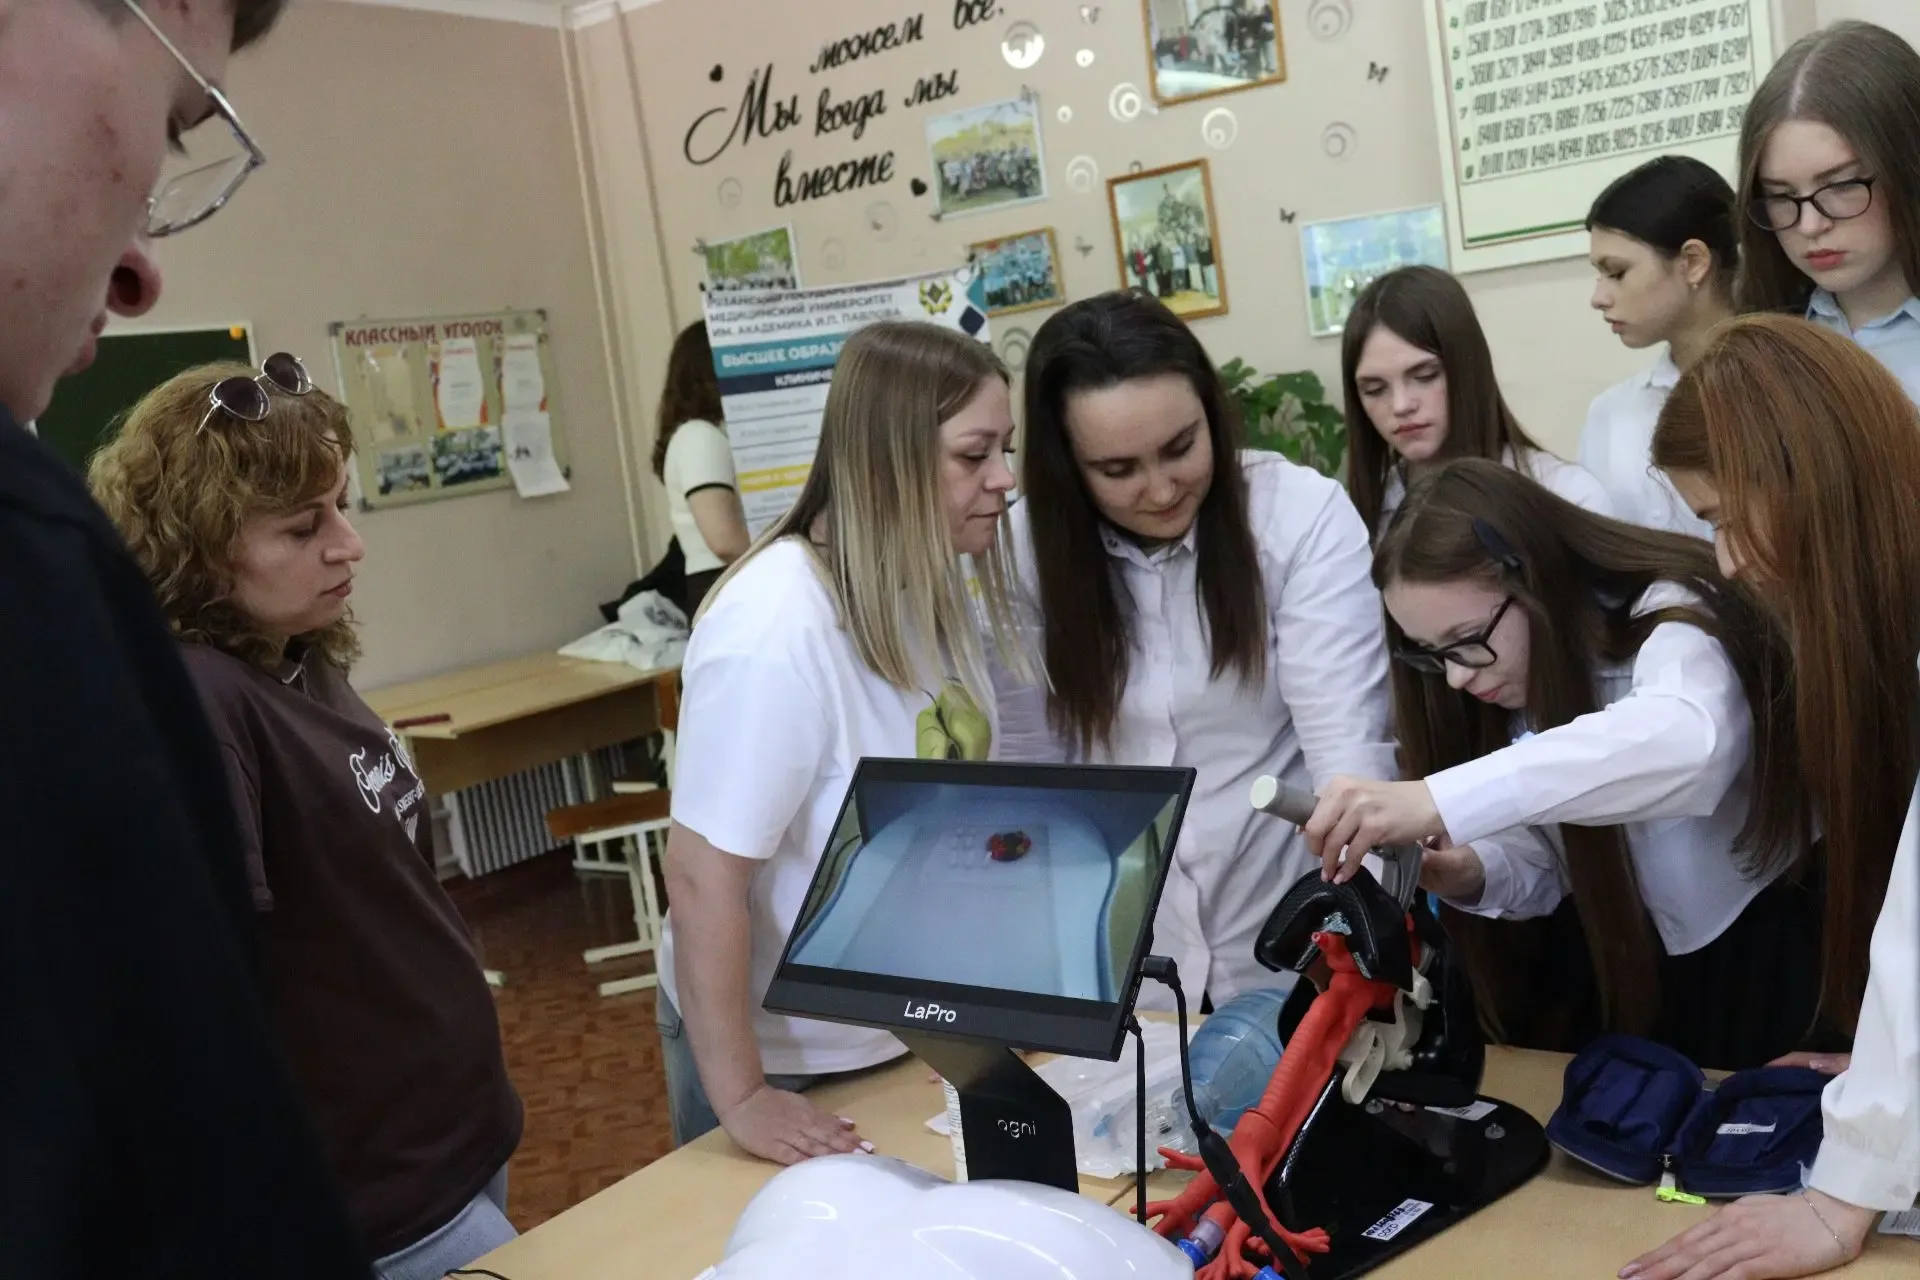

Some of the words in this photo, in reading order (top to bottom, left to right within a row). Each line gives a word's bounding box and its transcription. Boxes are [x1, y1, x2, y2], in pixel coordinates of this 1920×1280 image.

[684, 63, 801, 166] Мы
[814, 88, 888, 141] когда
[904, 69, 960, 109] мы
[773, 148, 896, 208] вместе
[345, 322, 437, 346] КЛАССНЫЙ
[443, 319, 504, 339] УГОЛОК
[721, 348, 786, 368] ВЫСШЕЕ
[903, 1001, 957, 1023] LaPro
